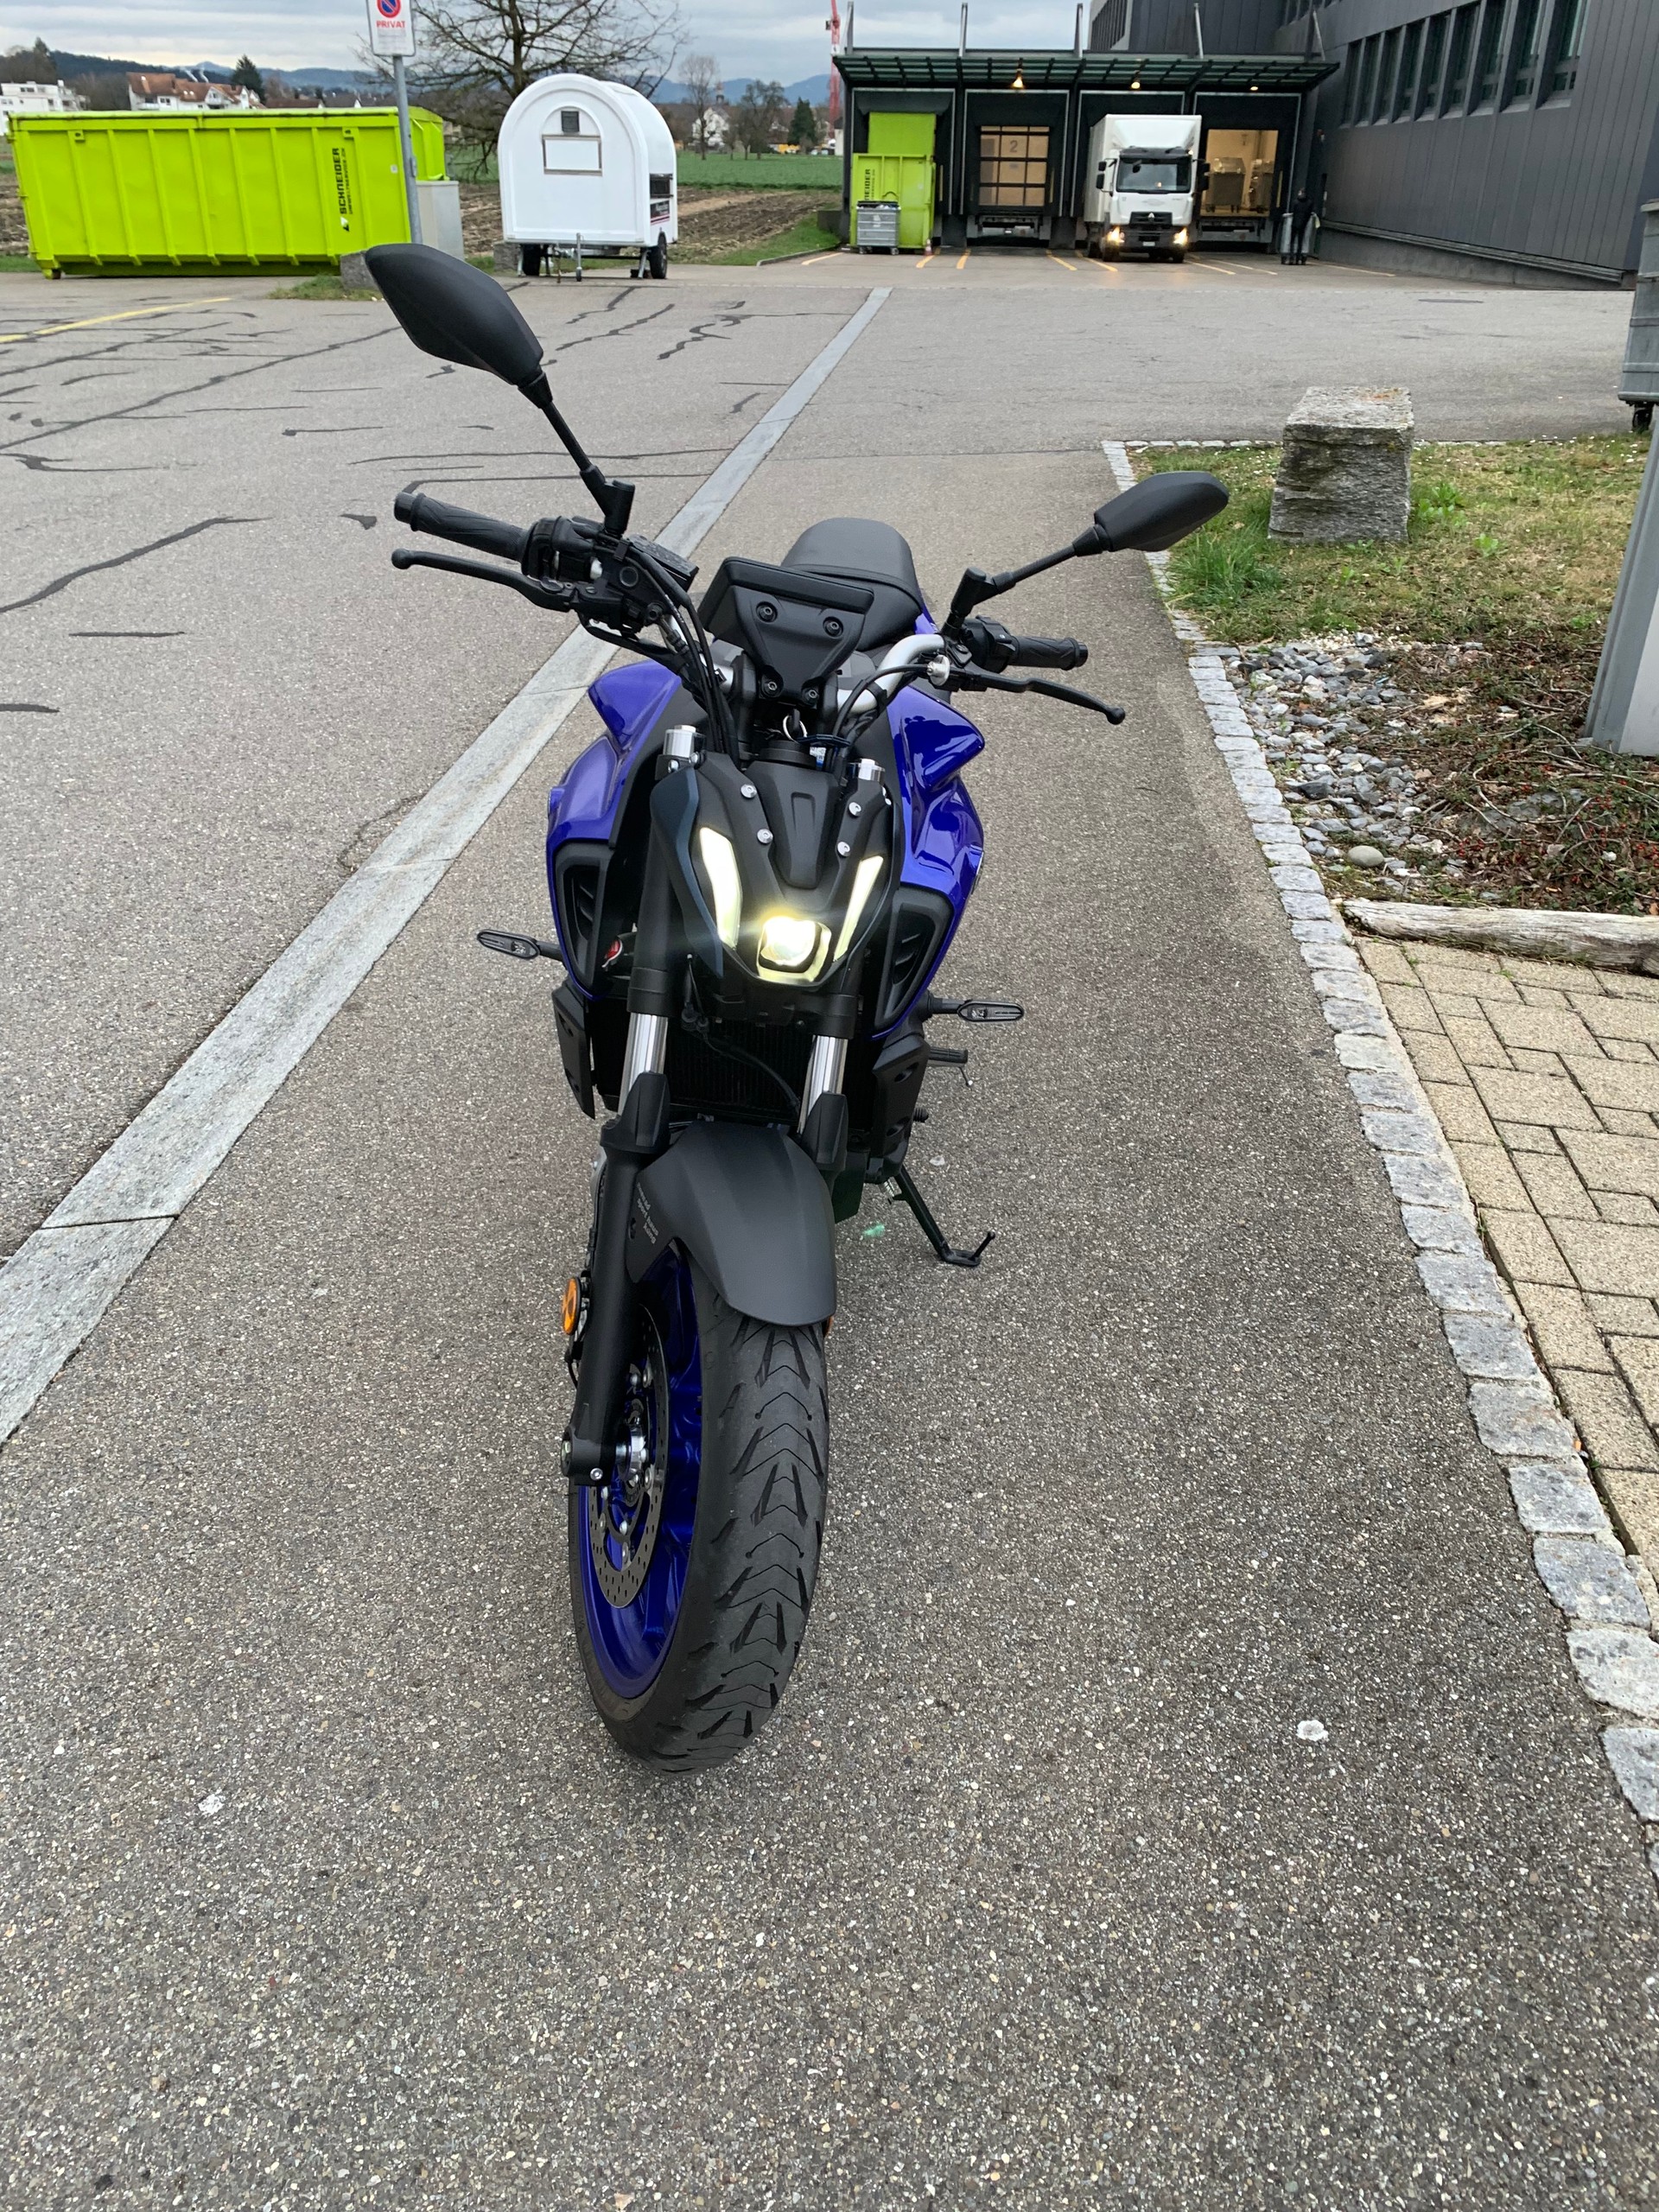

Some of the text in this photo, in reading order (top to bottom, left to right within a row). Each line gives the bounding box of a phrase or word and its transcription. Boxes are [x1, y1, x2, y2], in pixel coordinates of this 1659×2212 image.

[376, 20, 406, 29] PRIVAT
[1009, 140, 1019, 153] 2
[331, 148, 347, 214] SCHNEIDER
